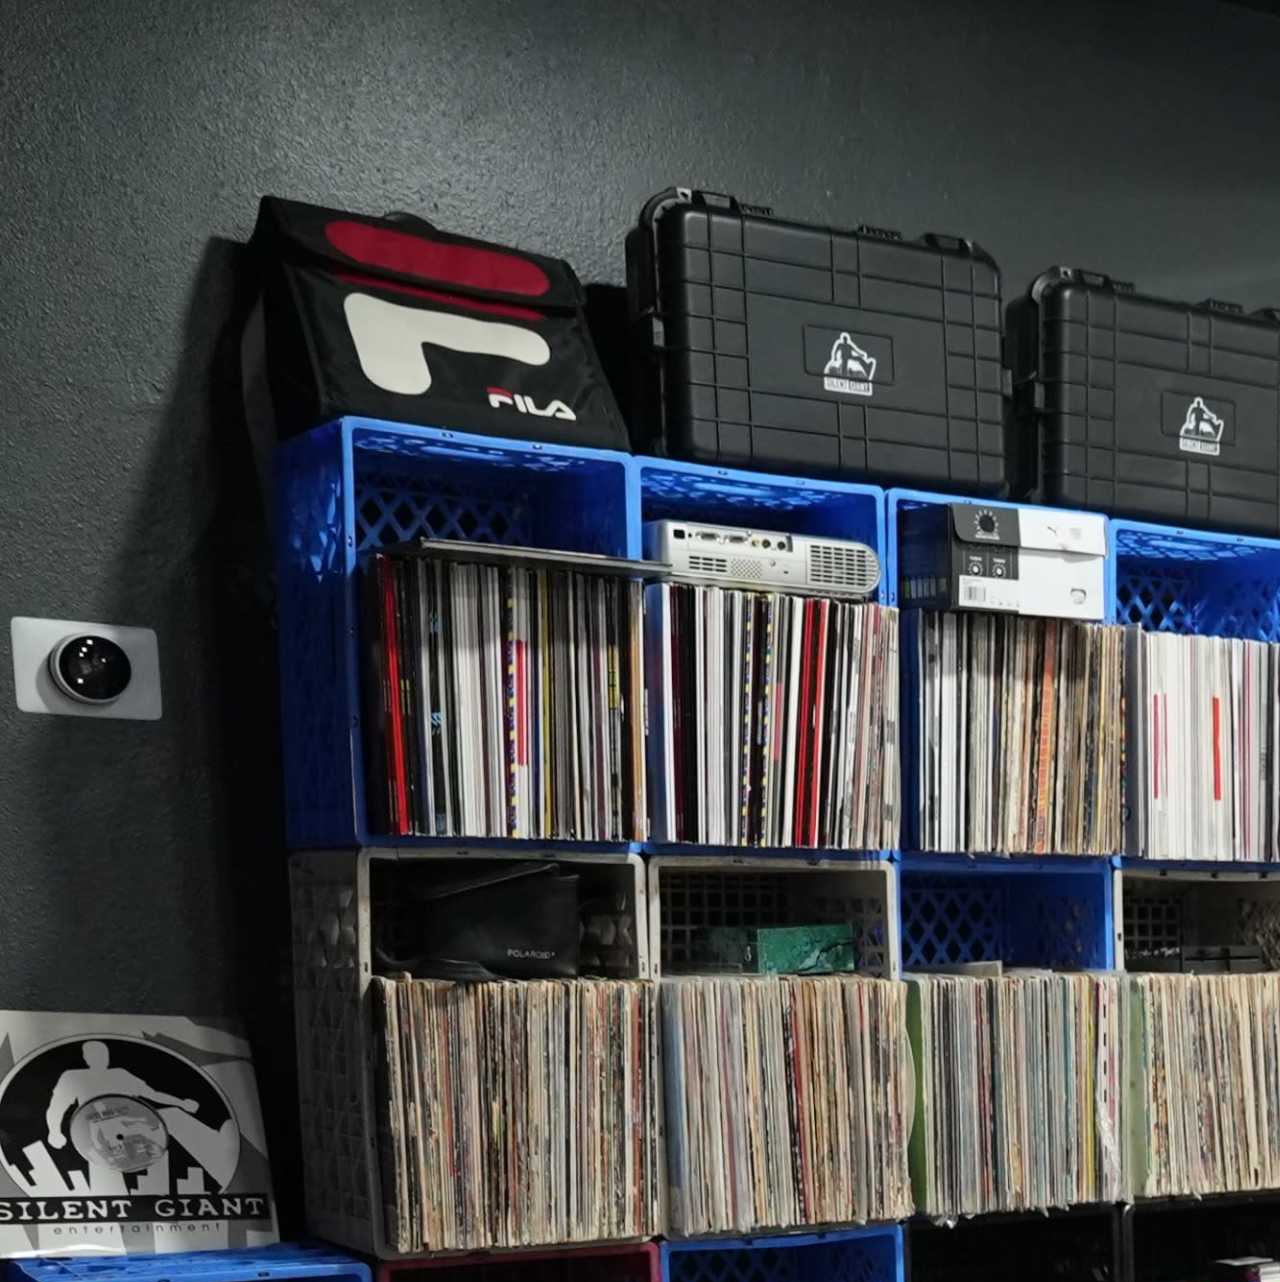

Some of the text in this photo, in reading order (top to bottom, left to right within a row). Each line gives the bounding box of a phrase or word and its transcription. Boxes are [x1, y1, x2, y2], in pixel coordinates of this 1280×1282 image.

[486, 386, 576, 421] FILA
[0, 1198, 263, 1220] SILENT GIANT
[53, 1222, 220, 1235] entertainment
